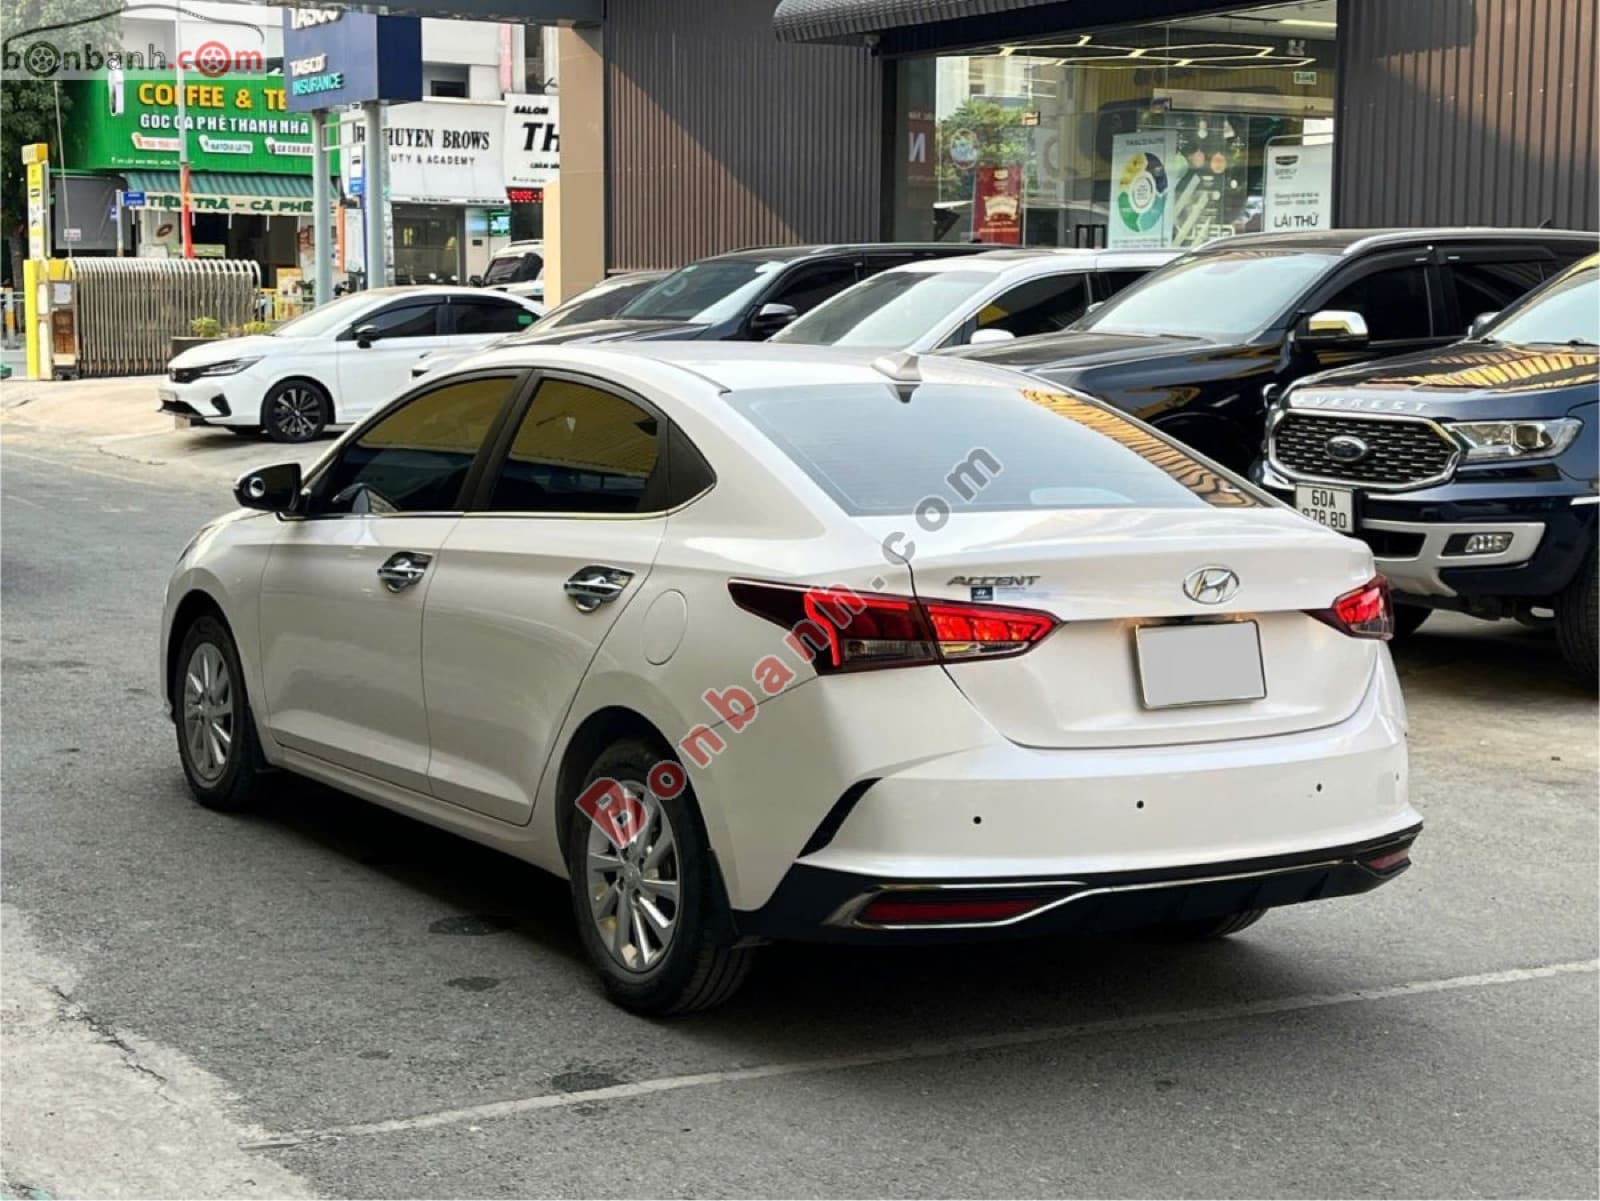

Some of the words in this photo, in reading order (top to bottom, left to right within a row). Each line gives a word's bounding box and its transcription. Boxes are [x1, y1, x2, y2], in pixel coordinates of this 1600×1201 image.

[292, 72, 343, 96] INSURANCE
[235, 89, 253, 108] &
[513, 105, 549, 115] SALON
[230, 118, 279, 133] THANH
[443, 129, 490, 150] BROWS
[427, 155, 475, 165] ACADEMY
[1296, 394, 1430, 412] EVEREST
[1311, 490, 1337, 509] 60A
[946, 575, 1042, 586] ACCENT
